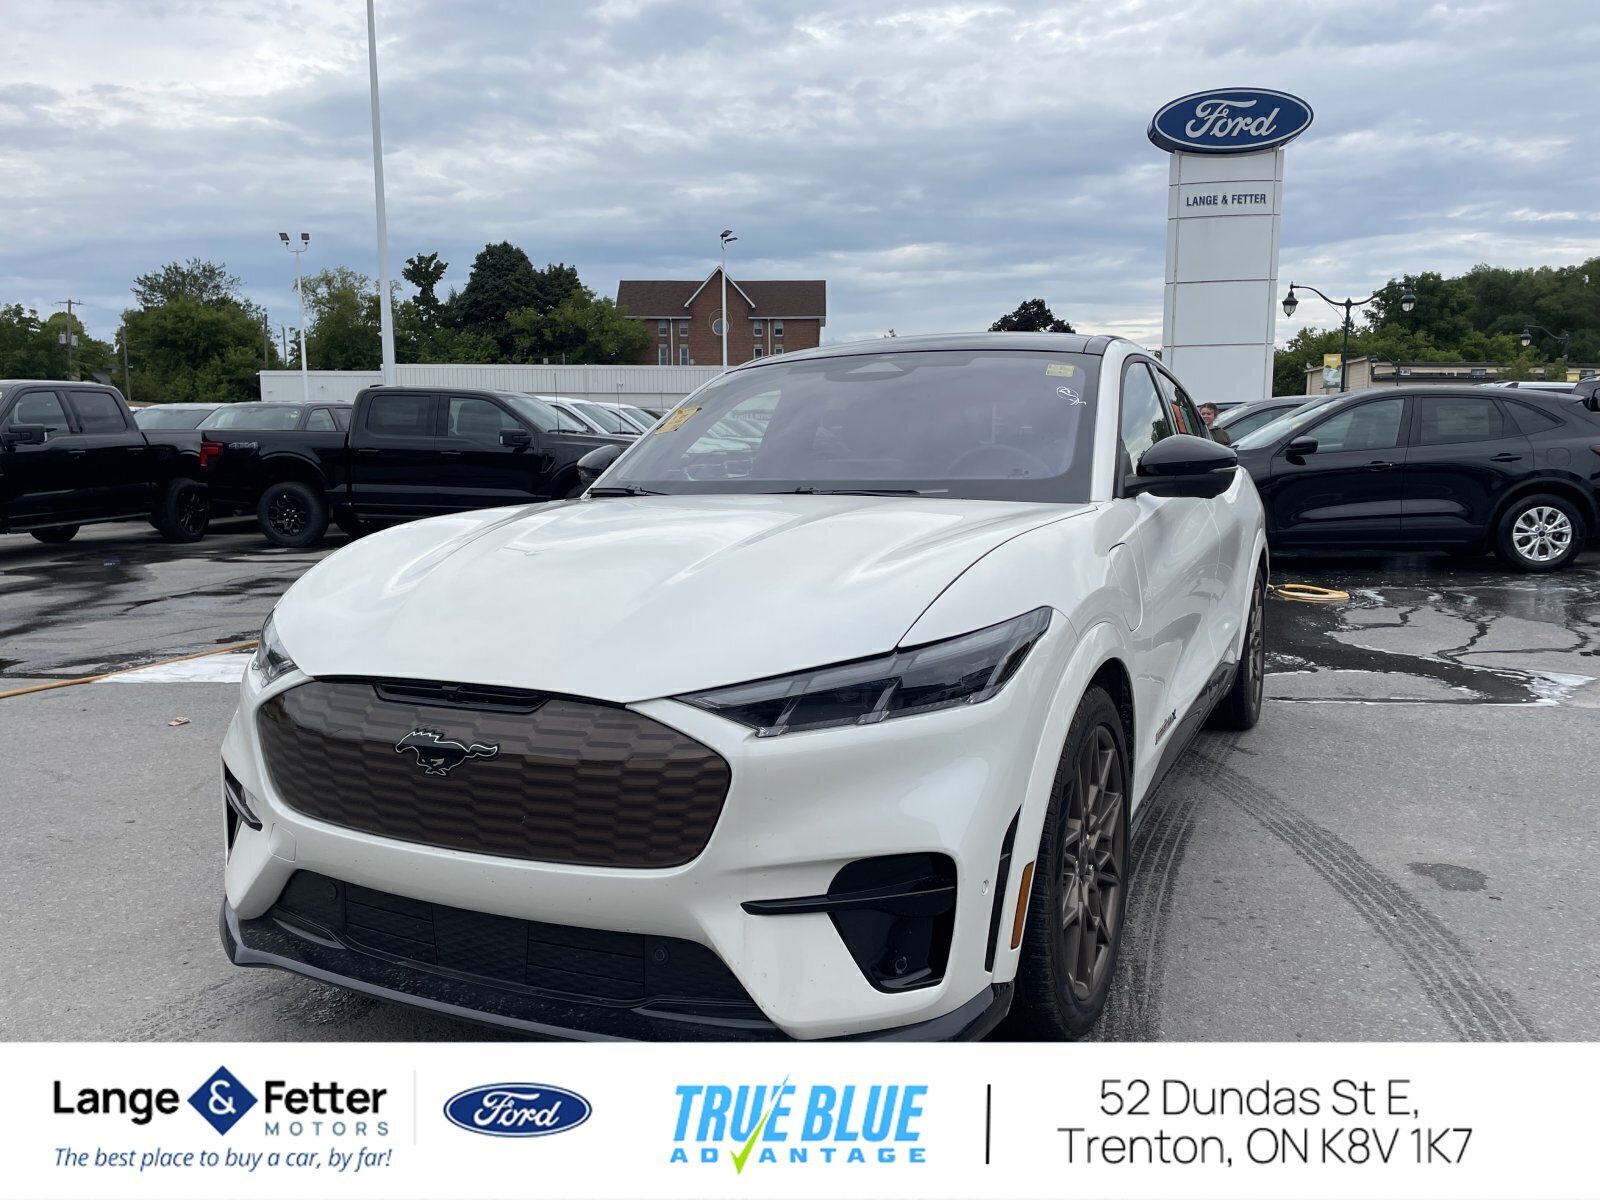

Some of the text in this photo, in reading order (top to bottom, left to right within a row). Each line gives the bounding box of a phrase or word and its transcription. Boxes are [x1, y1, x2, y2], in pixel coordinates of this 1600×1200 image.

[1185, 99, 1280, 138] Ford
[1186, 193, 1266, 207] LANGE & FETTER
